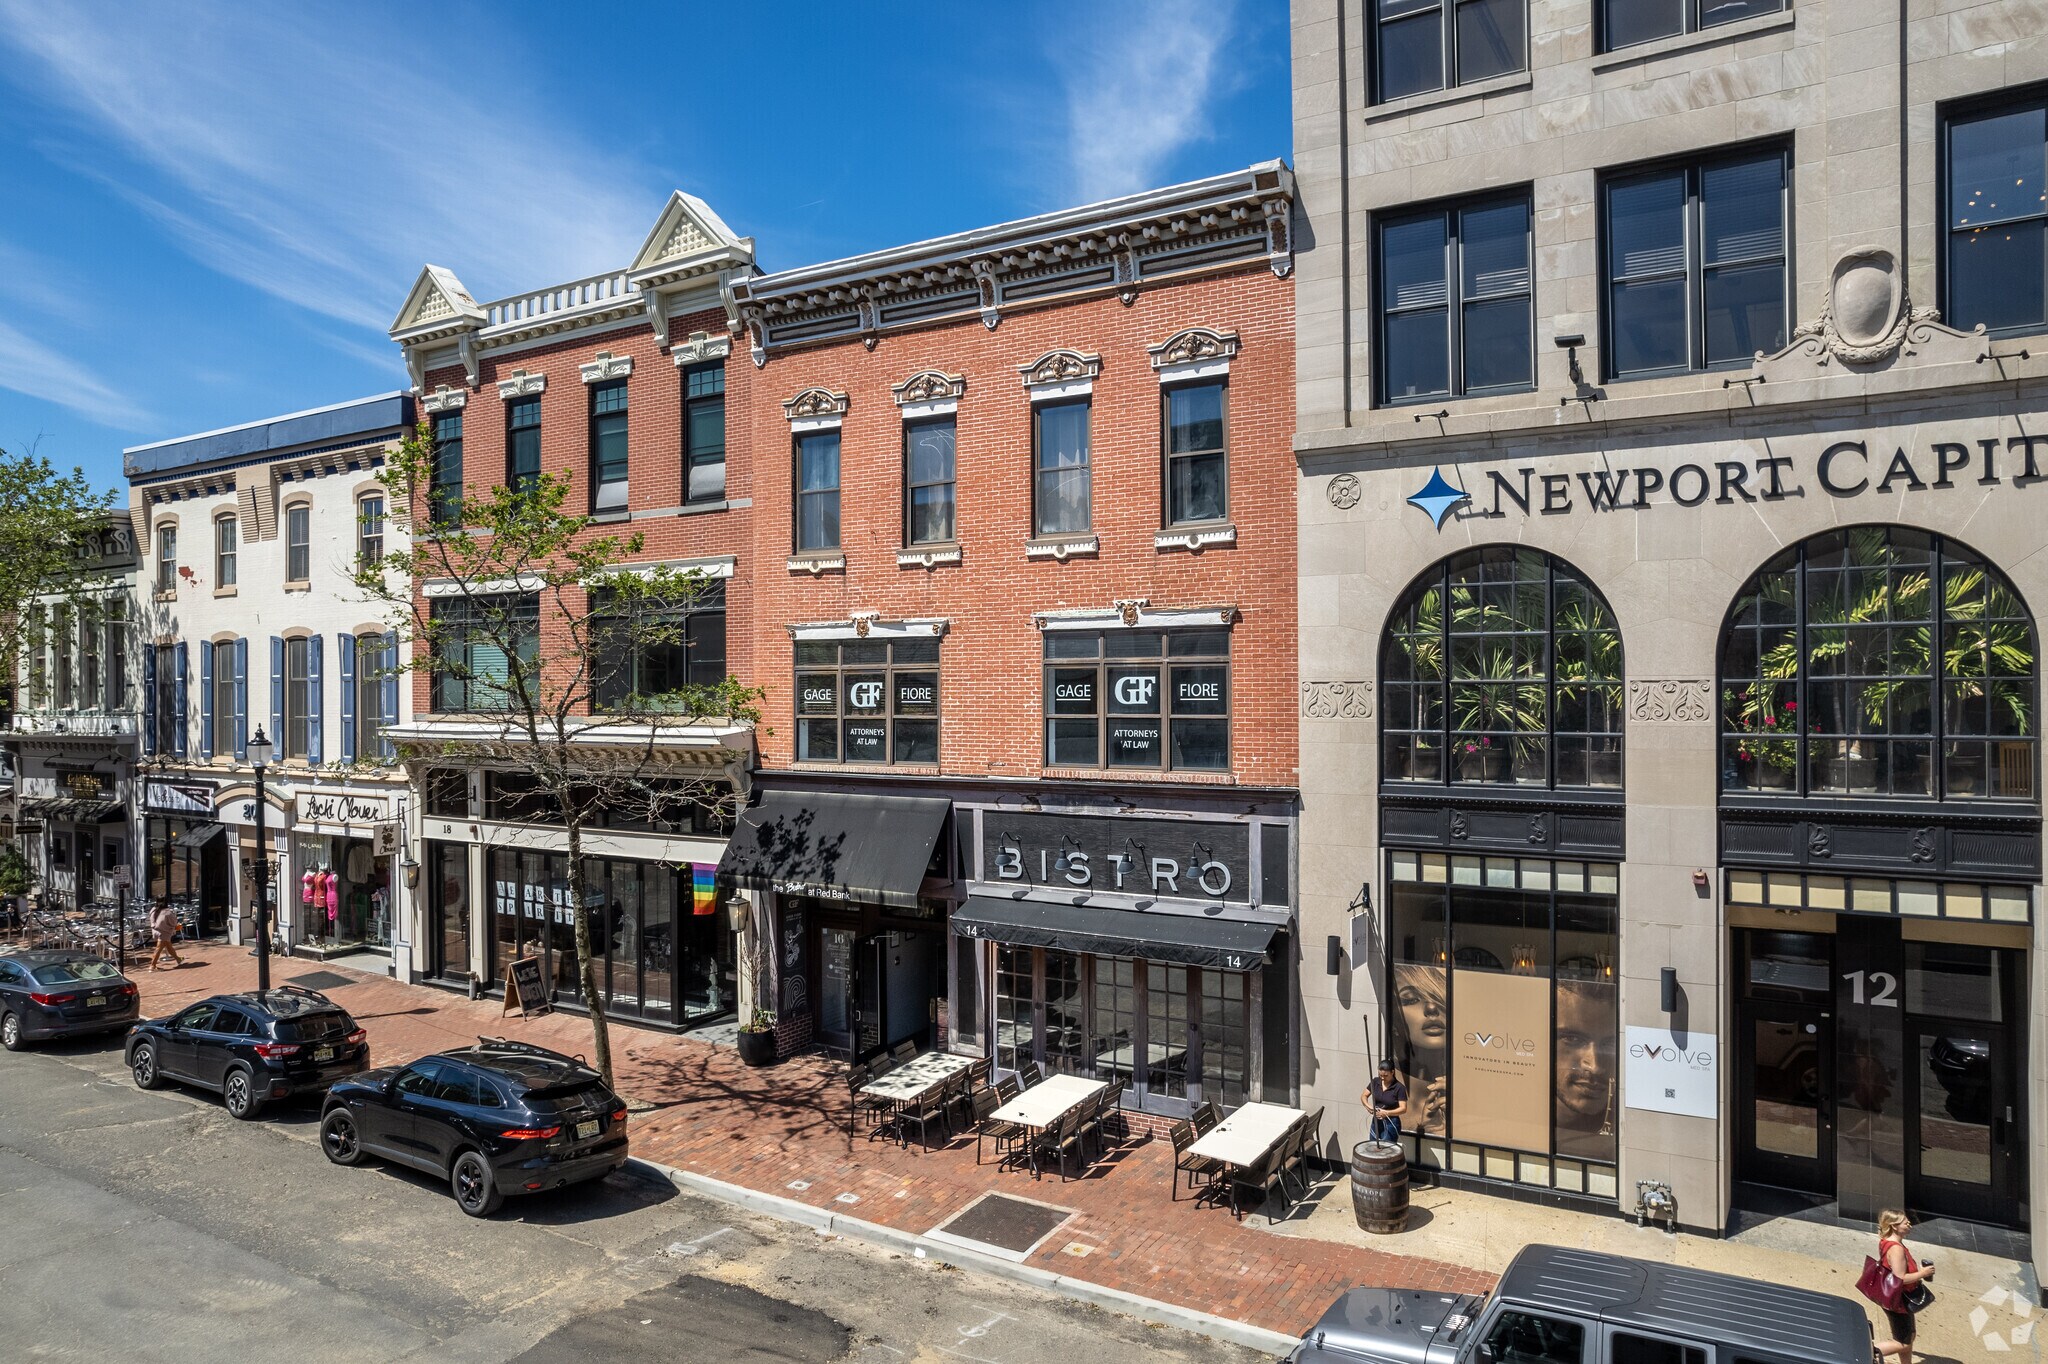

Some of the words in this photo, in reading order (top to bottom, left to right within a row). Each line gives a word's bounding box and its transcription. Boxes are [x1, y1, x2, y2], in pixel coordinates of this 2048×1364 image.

[1486, 457, 1794, 518] NEWPORT
[804, 688, 832, 701] GAGE
[901, 687, 931, 700] FIORE
[1056, 684, 1091, 698] GAGE
[1180, 683, 1219, 697] FIORE
[849, 728, 885, 736] ATTORNEYS
[1114, 729, 1158, 738] ATTORNEYS
[865, 738, 878, 746] LAW
[1122, 740, 1132, 749] AT
[1133, 741, 1149, 749] LAW
[306, 795, 334, 820] Lucki
[337, 796, 379, 822] Clover
[443, 824, 452, 834] 18
[998, 847, 1232, 896] BISTRO
[772, 884, 783, 893] the
[808, 888, 815, 896] at
[816, 889, 831, 898] Red
[832, 890, 850, 900] Bank
[966, 925, 977, 936] 14
[834, 933, 844, 944] 16
[1226, 955, 1241, 968] 14
[1842, 970, 1898, 1008] 12
[1463, 1032, 1535, 1052] evolve
[1463, 1055, 1501, 1063] INNOVATORS
[1630, 1044, 1712, 1066] evolve
